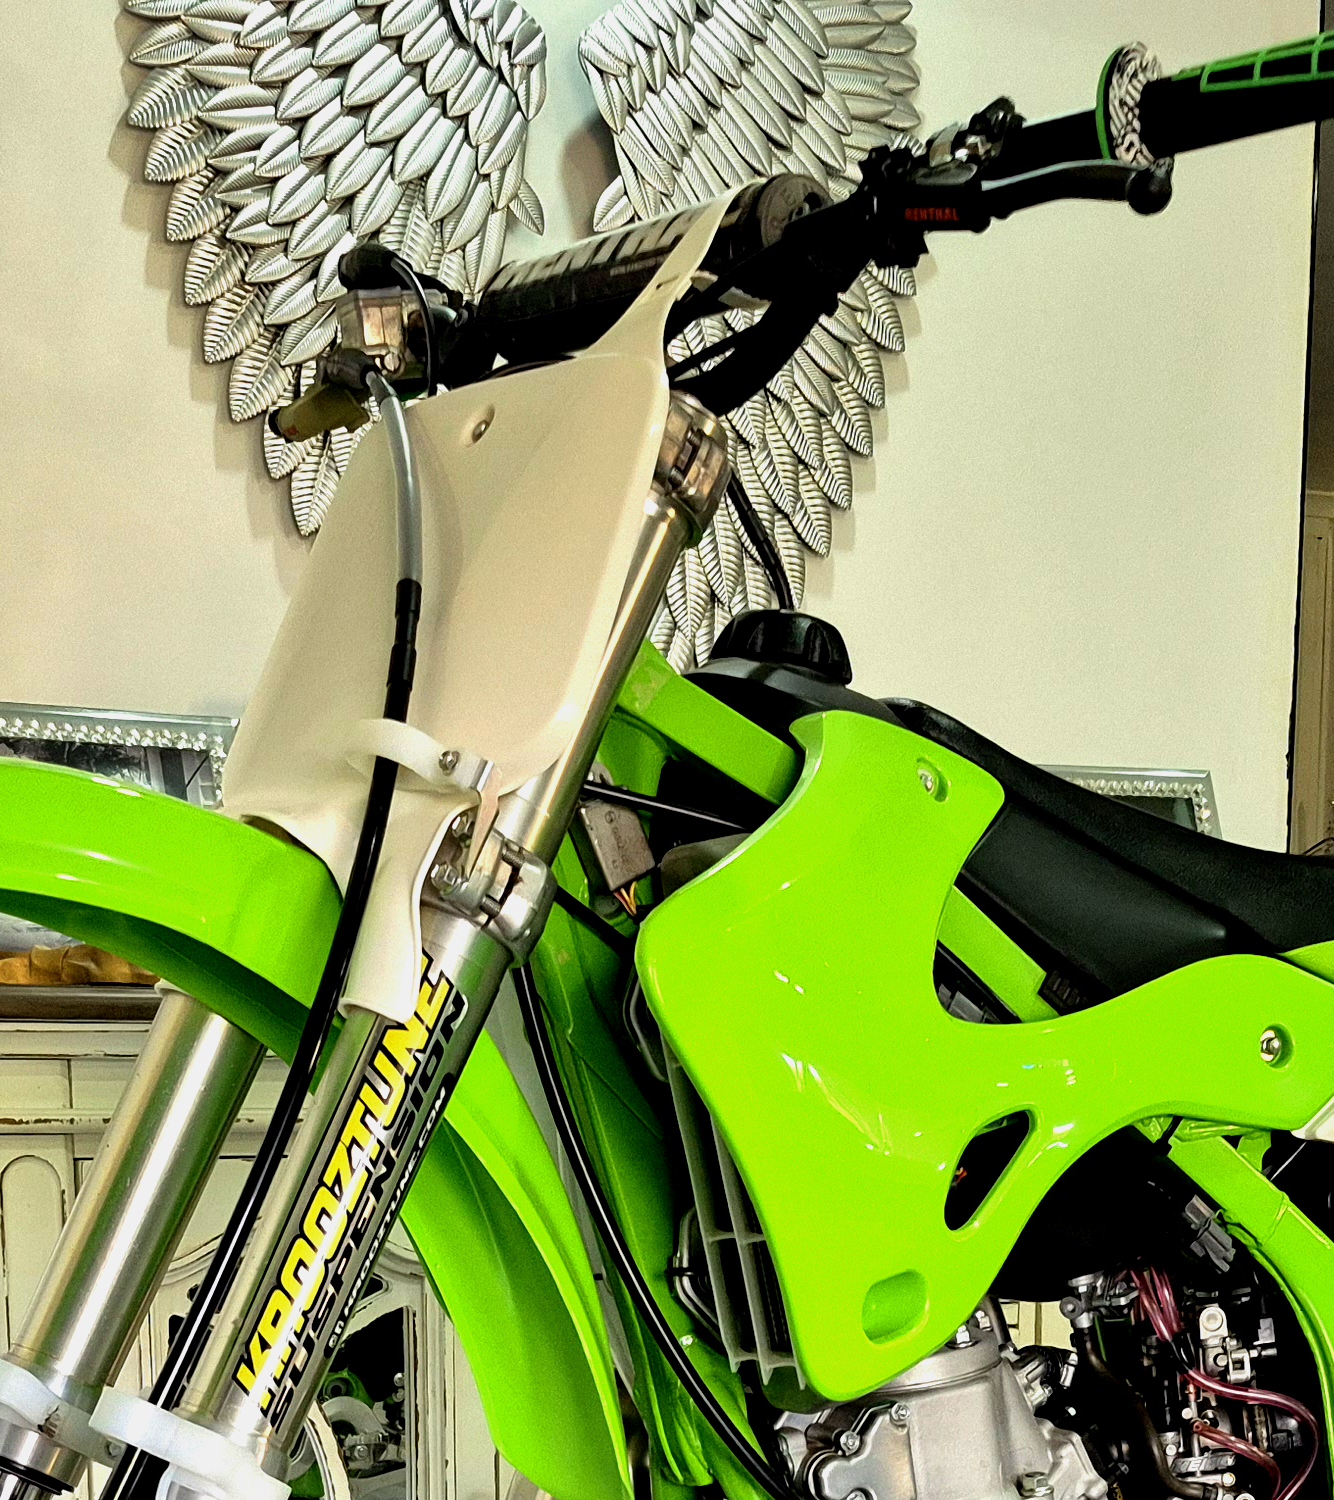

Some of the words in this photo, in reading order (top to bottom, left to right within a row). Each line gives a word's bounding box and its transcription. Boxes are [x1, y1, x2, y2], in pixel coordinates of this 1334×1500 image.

[234, 949, 453, 1417] KROOZTUNE
[270, 990, 466, 1434] SUSPENSION
[343, 1086, 446, 1318] KROOZTUNE.COM
